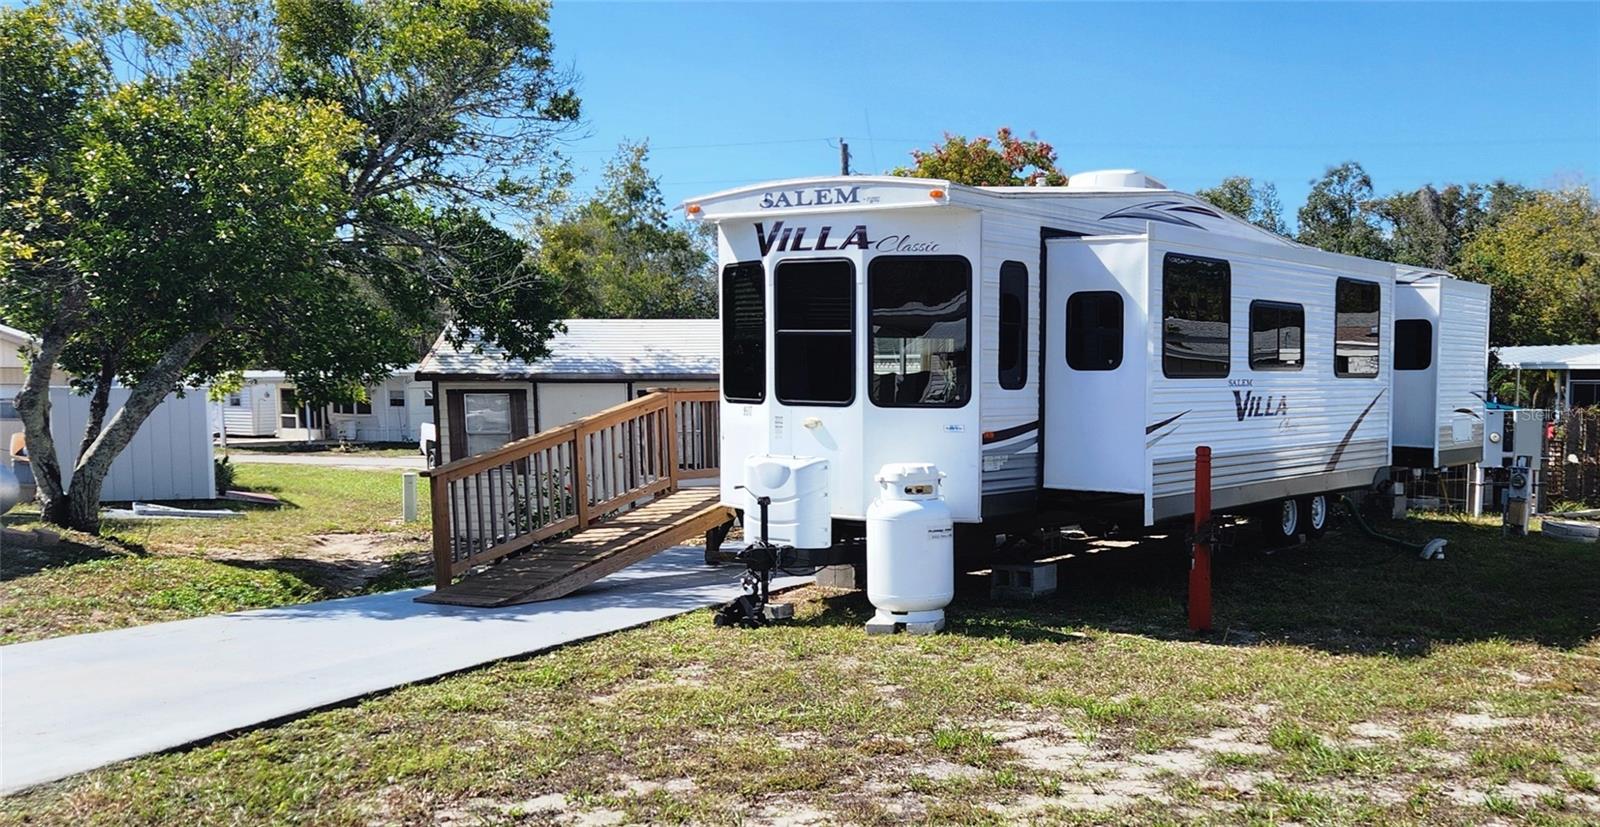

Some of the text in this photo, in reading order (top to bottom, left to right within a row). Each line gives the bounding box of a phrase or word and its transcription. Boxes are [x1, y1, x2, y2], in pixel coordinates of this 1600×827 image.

[759, 187, 860, 209] SALEM
[753, 221, 940, 257] VILLA Classic
[1228, 379, 1253, 387] SALEM
[1232, 390, 1288, 422] VILLA
